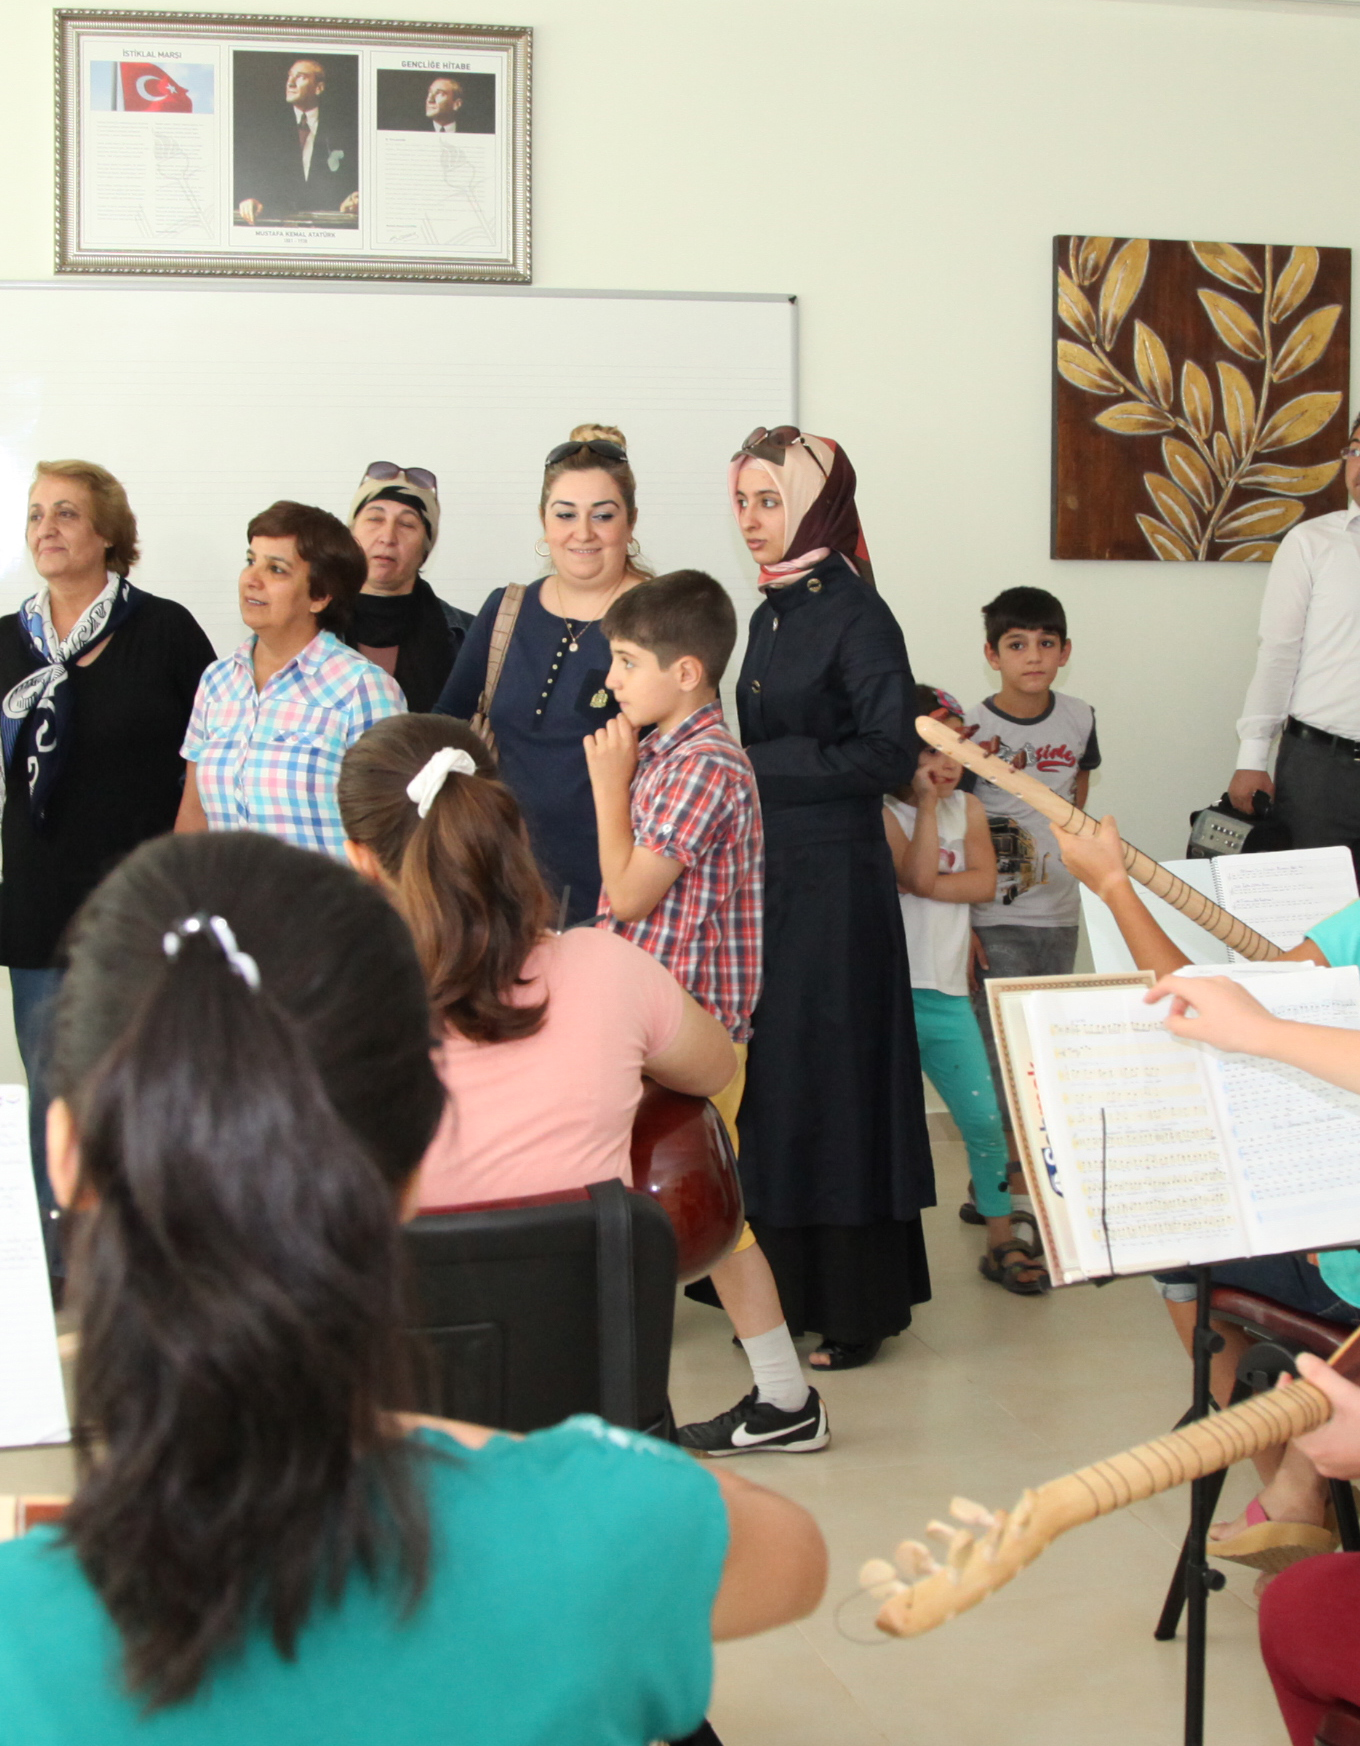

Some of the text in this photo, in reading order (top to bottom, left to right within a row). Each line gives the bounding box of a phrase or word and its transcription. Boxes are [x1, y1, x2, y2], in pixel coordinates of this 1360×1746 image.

[122, 48, 182, 59] İSTİKLAL MARŞI
[442, 61, 471, 70] HİTABE
